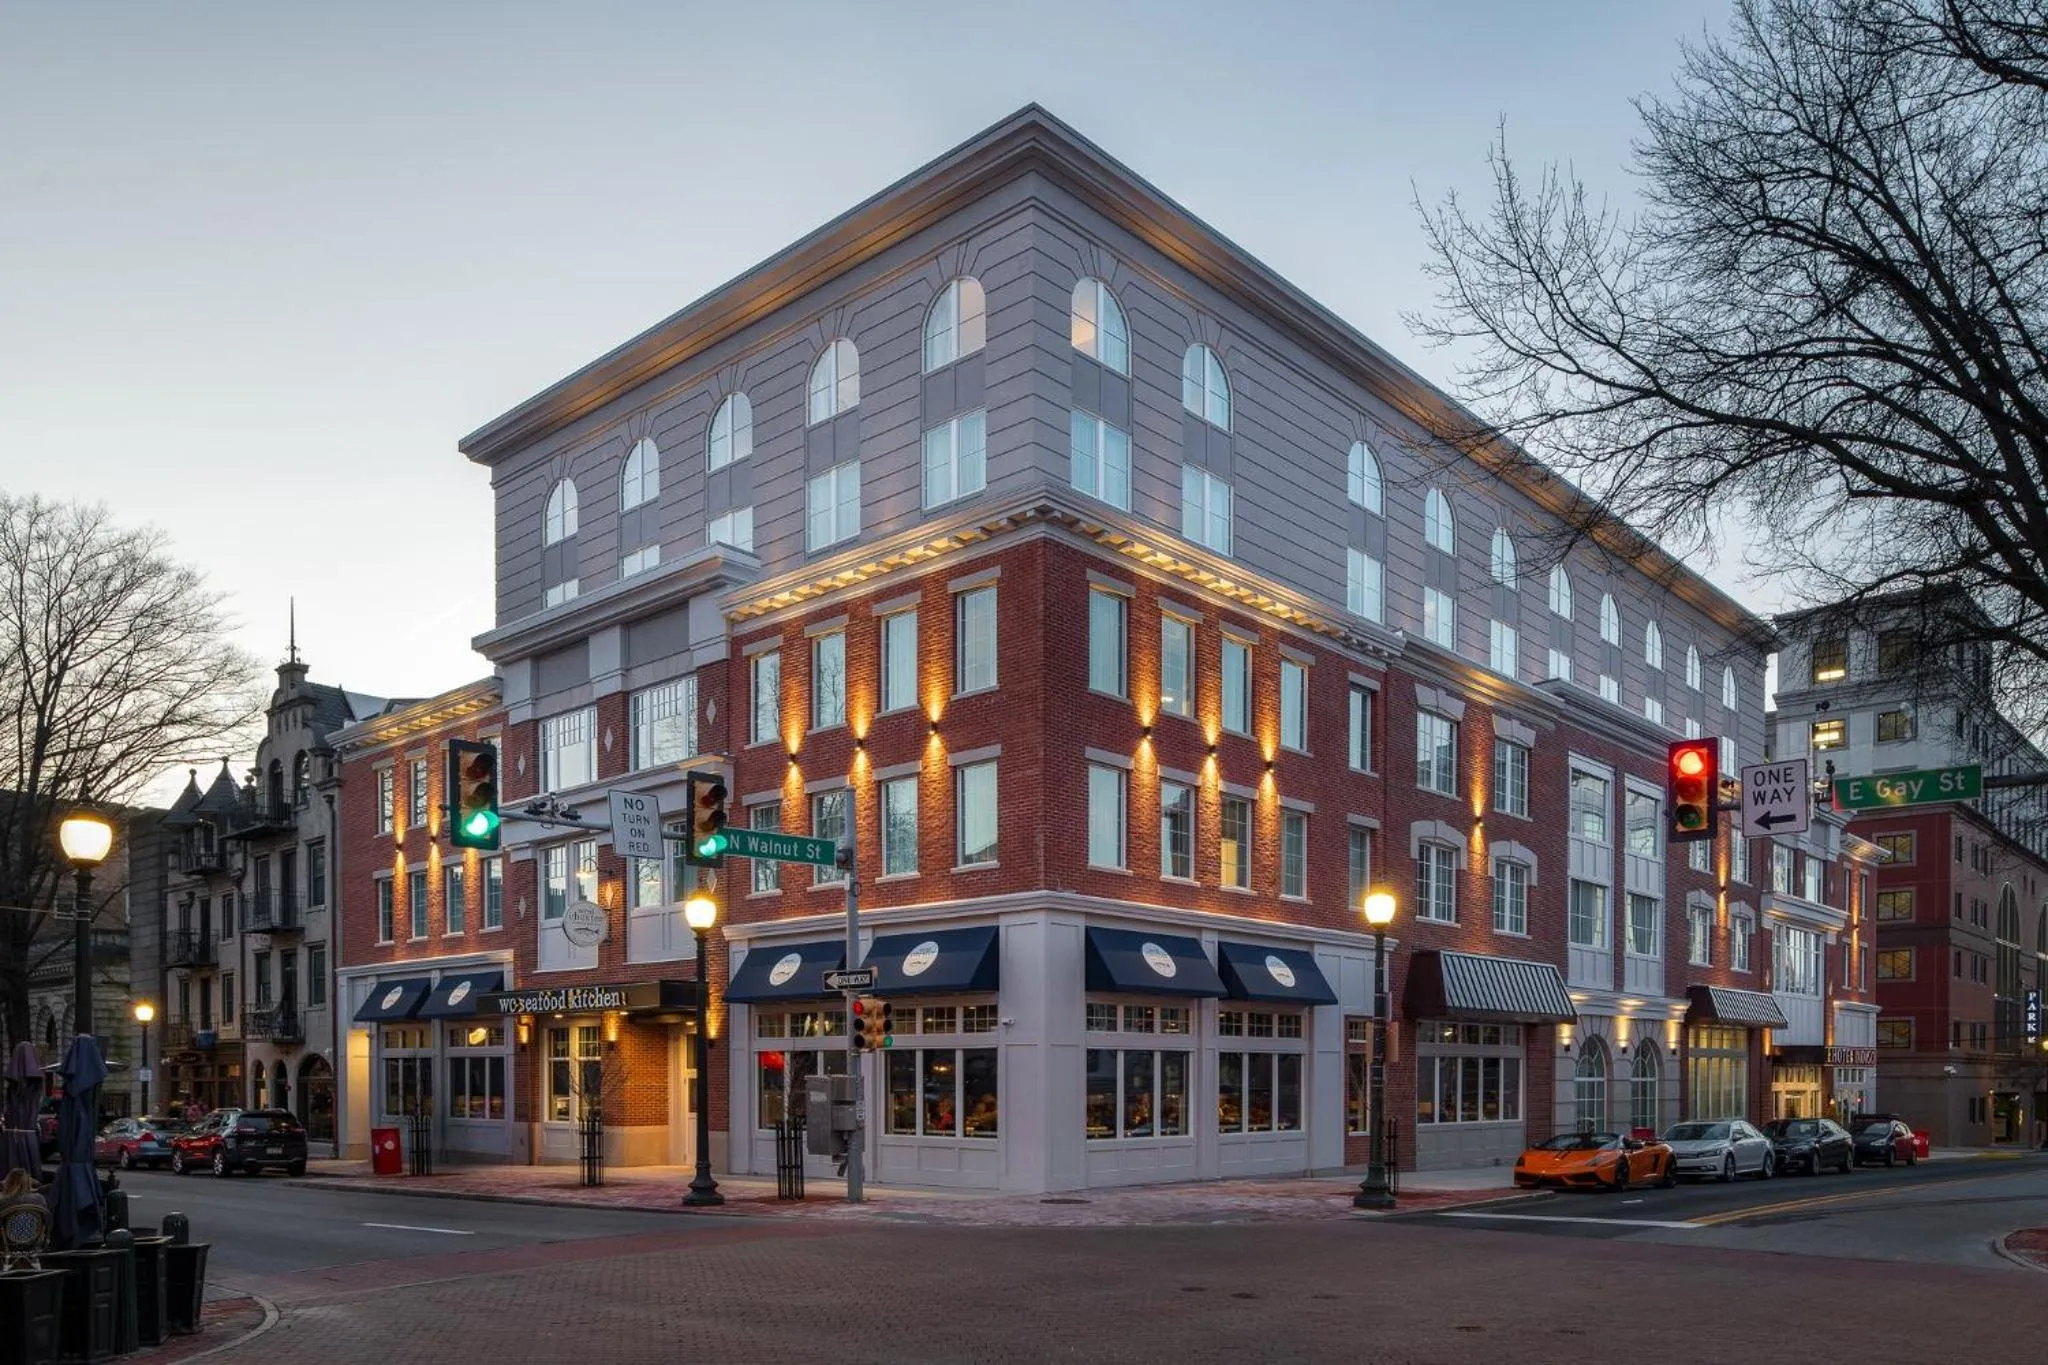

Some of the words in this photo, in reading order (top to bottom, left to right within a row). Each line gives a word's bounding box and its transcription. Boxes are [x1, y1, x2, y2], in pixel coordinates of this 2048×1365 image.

[1753, 766, 1796, 787] ONE
[1849, 781, 1865, 801] E
[1875, 778, 1924, 800] Gay
[1939, 771, 1966, 792] St
[623, 796, 645, 811] NO
[1752, 785, 1796, 806] WAY
[621, 812, 651, 826] TURN
[630, 827, 646, 839] ON
[627, 841, 650, 853] RED
[729, 833, 740, 850] N
[747, 835, 799, 857] Walnut
[806, 842, 822, 859] St
[855, 974, 870, 985] WAY
[2027, 991, 2038, 1032] PARK
